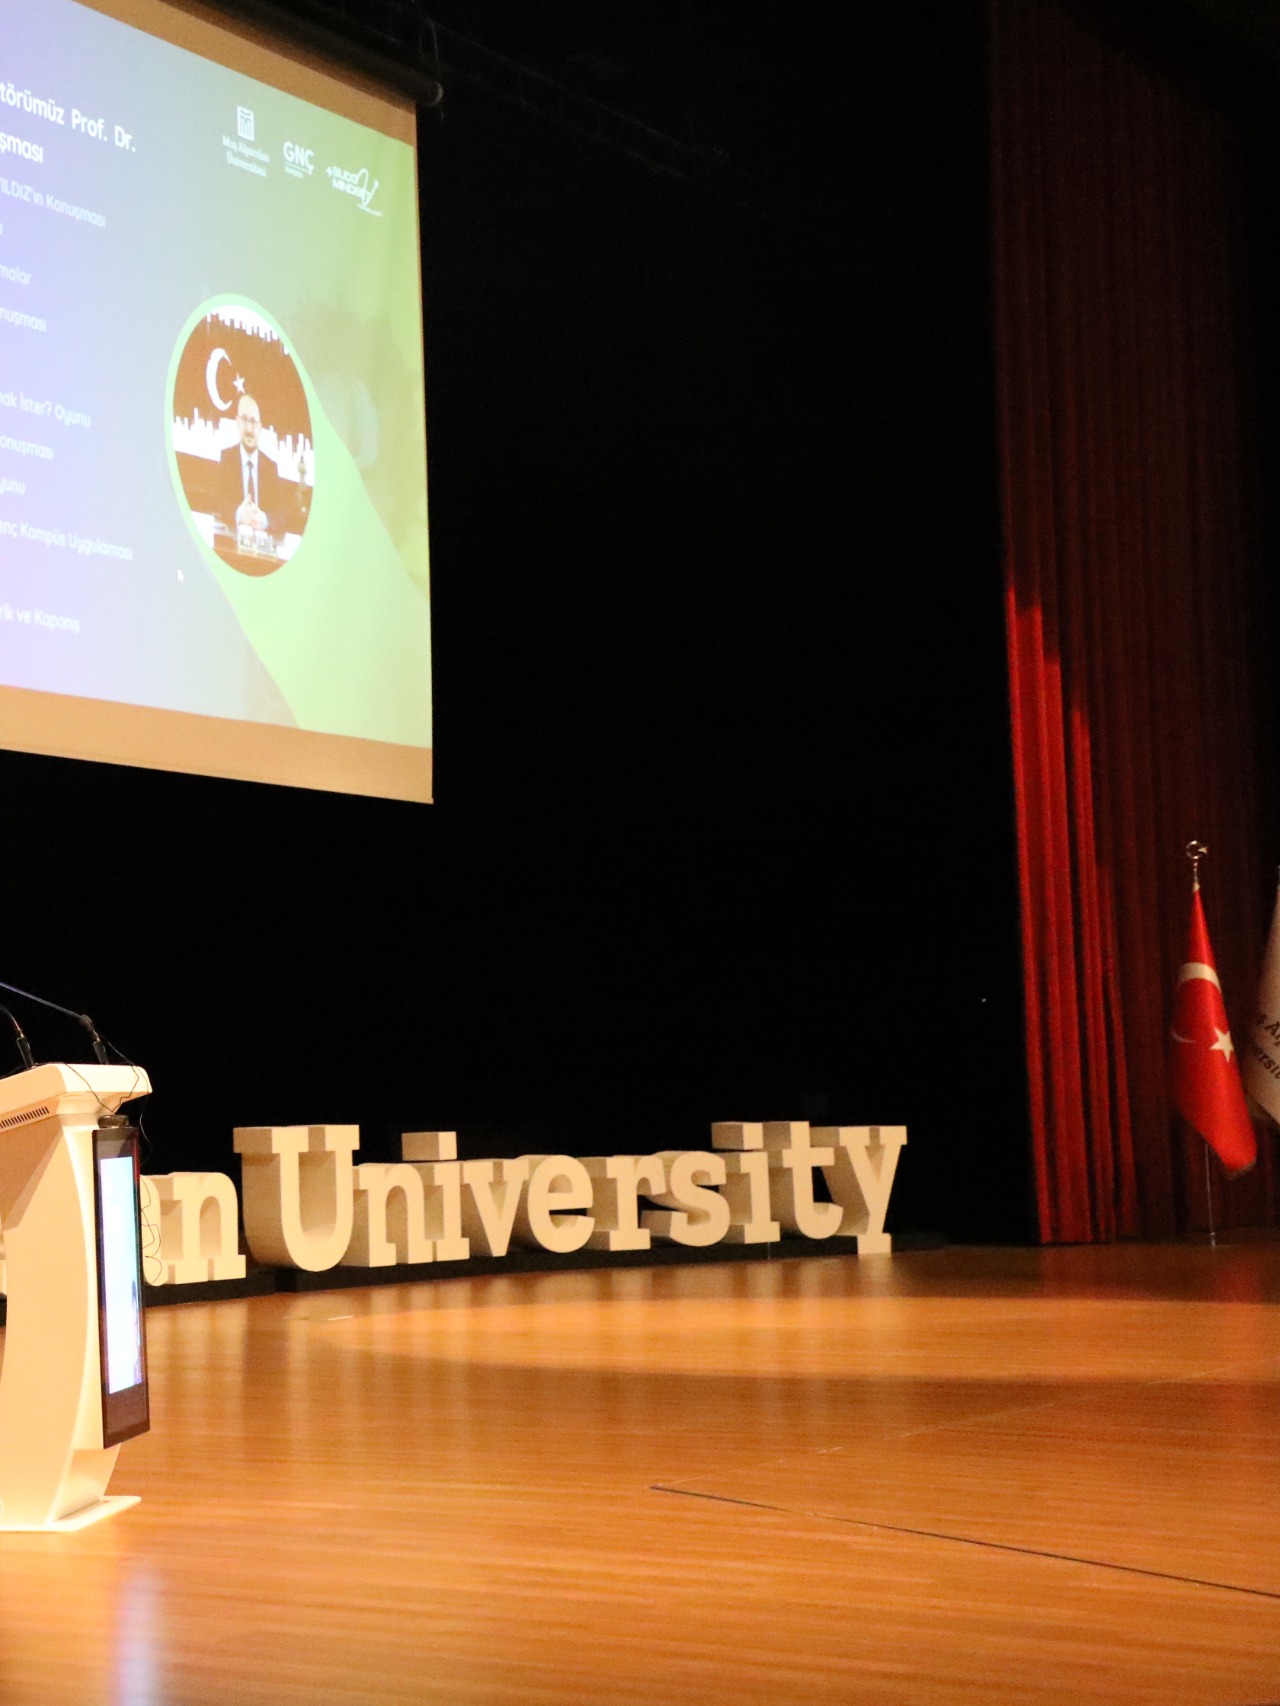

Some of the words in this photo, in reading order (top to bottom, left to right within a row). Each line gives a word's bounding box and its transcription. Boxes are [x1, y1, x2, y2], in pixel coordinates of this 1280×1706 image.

[72, 108, 108, 142] Prof.
[114, 125, 136, 152] Dr.
[46, 193, 106, 228] Konuşması
[20, 392, 52, 417] İster?
[55, 404, 91, 428] Oyunu
[20, 522, 66, 547] Kampüs
[69, 532, 133, 561] Uygulaması
[17, 609, 31, 624] ve
[34, 609, 80, 634] Kapanış
[232, 1120, 907, 1273] University
